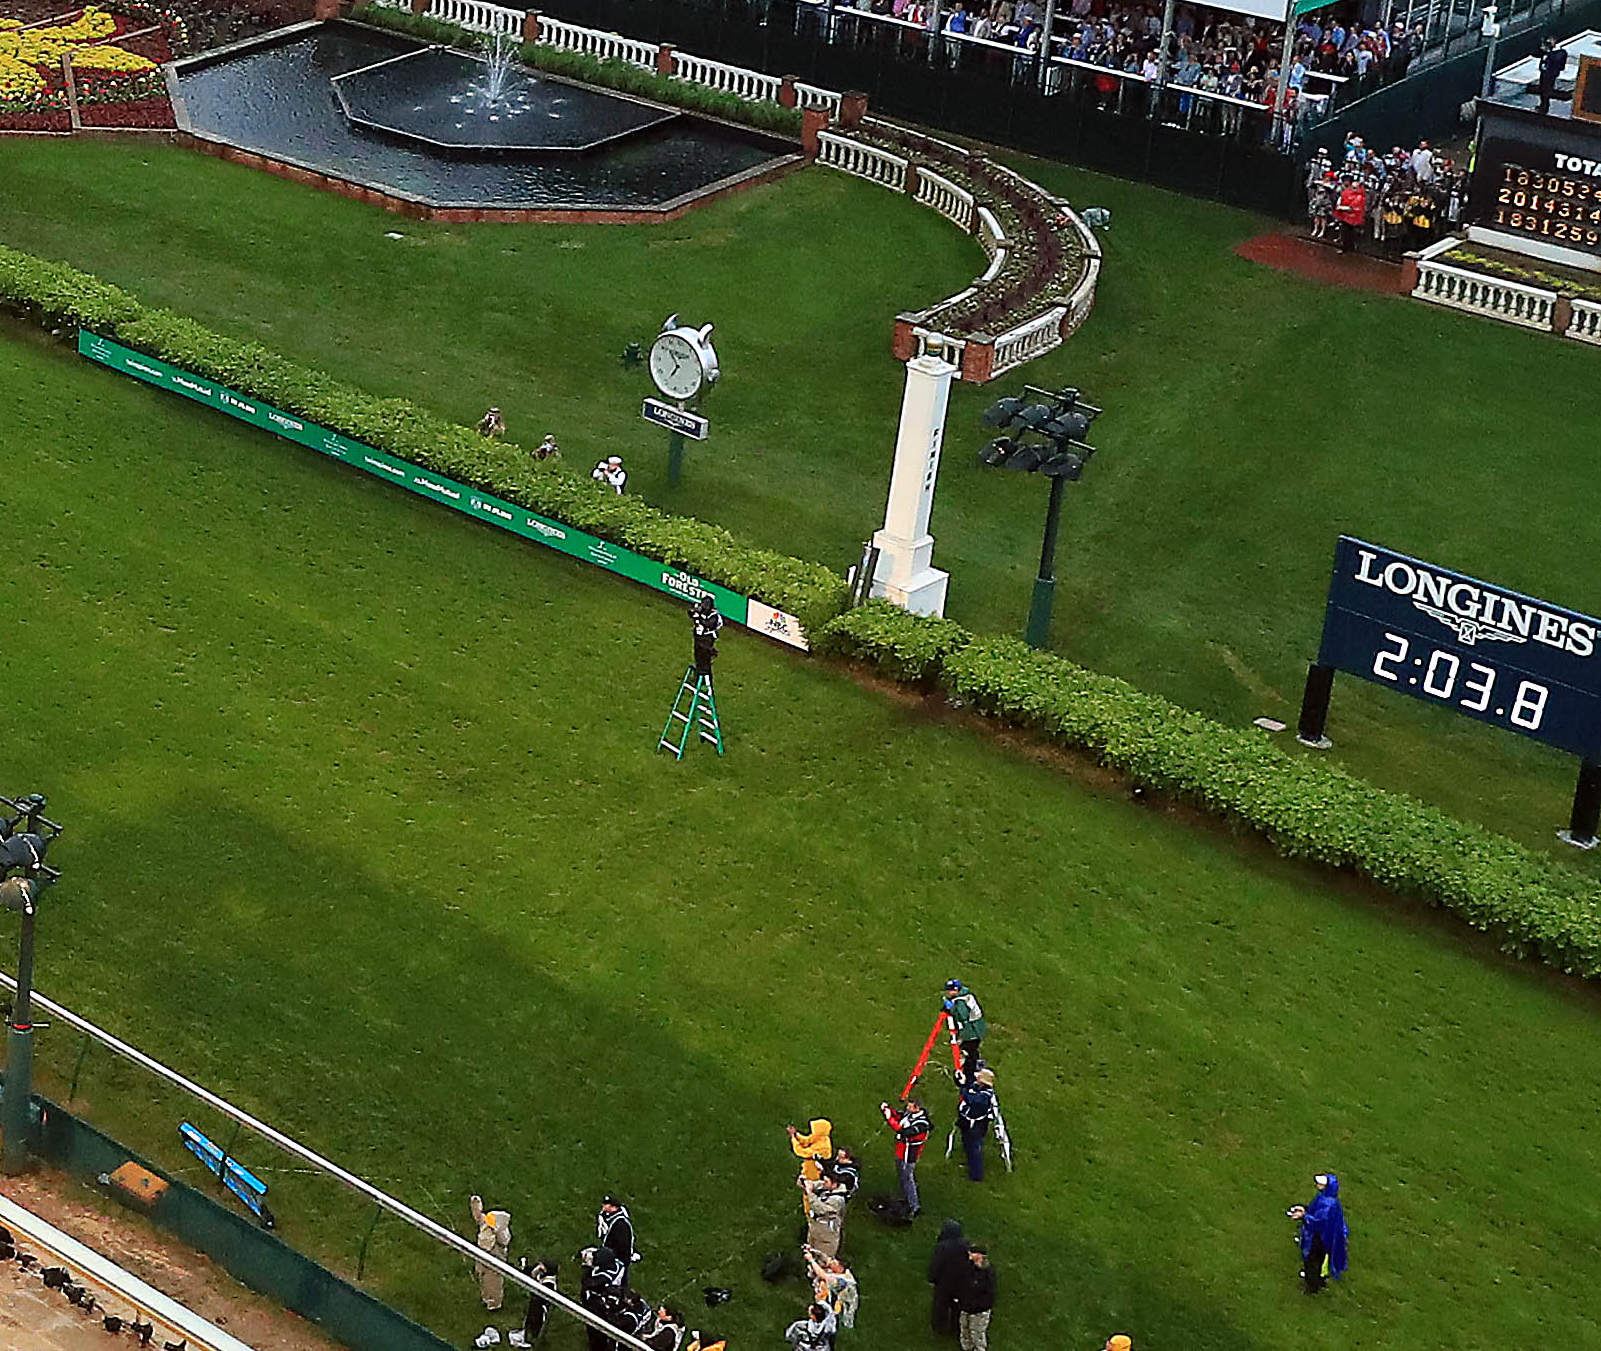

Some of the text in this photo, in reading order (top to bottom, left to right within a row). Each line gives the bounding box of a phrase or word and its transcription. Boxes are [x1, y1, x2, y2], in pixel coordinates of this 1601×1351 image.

[1495, 210, 1598, 245] 1831259
[1354, 550, 1596, 657] LONGINES
[1373, 632, 1549, 730] 2:03.8
